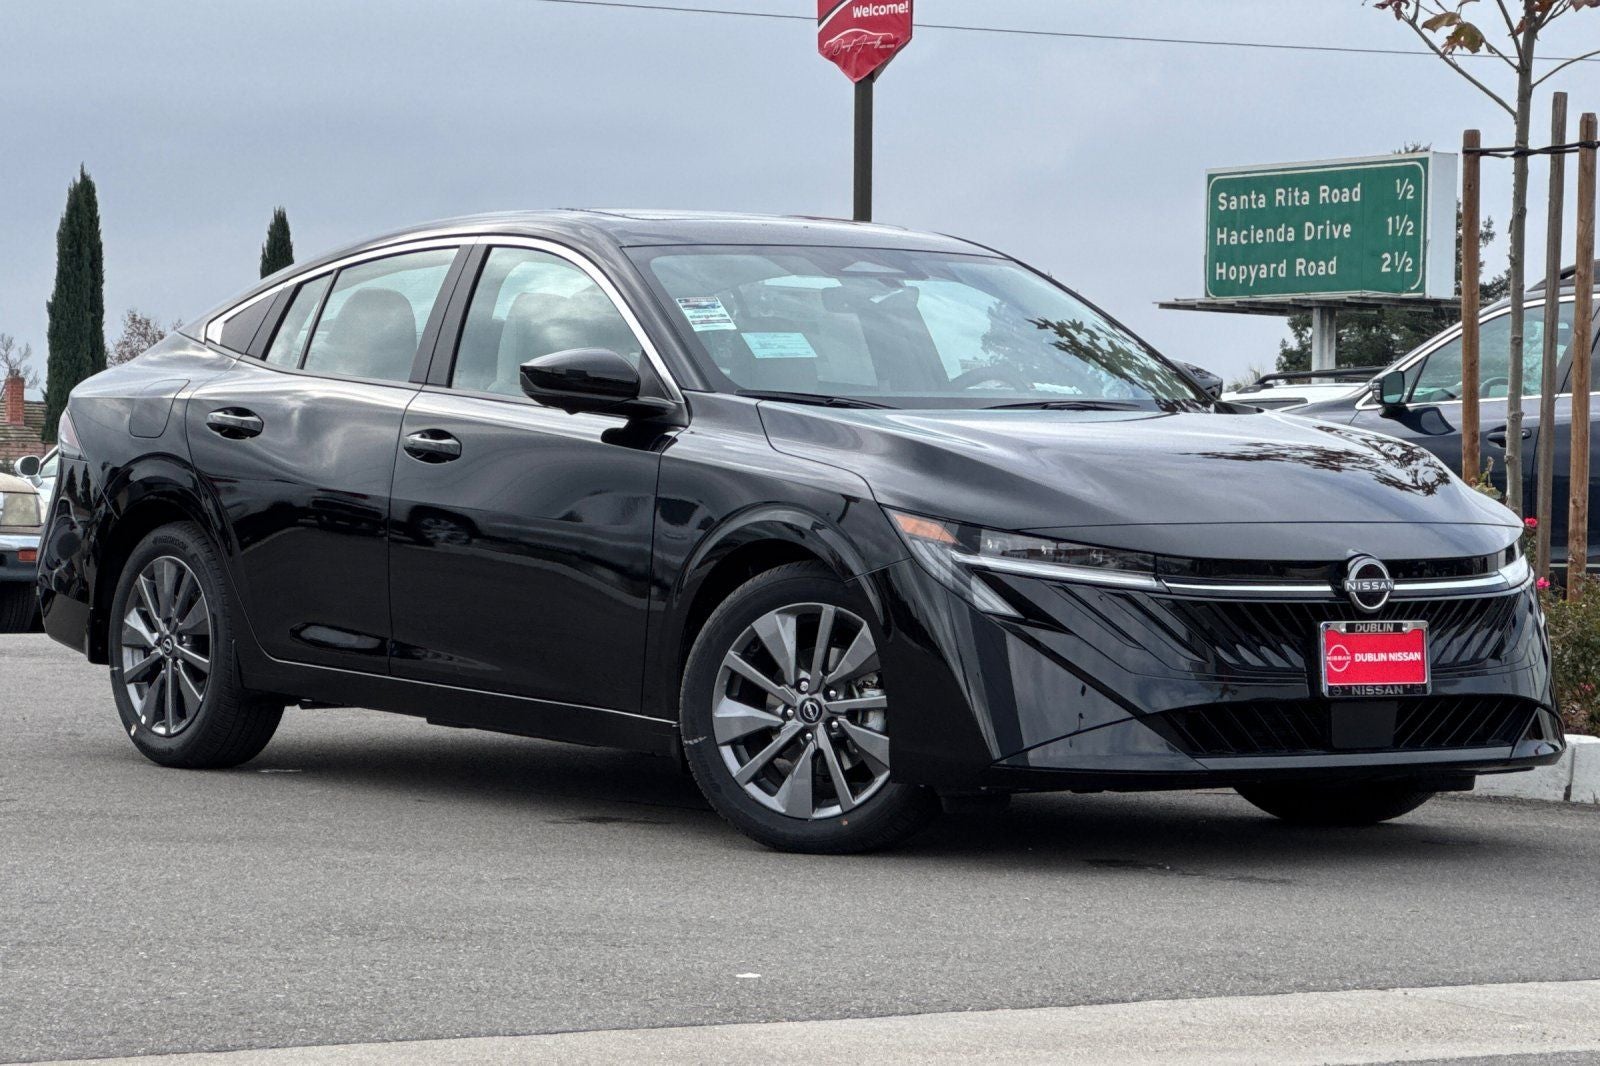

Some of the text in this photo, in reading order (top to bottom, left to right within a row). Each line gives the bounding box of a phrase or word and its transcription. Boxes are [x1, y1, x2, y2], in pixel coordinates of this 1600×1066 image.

[852, 1, 909, 18] Welcome!
[1218, 191, 1266, 211] Santa
[1275, 187, 1310, 207] Rita
[1319, 182, 1361, 204] Road
[1216, 223, 1295, 246] Hacienda
[1304, 220, 1351, 241] Drive
[1215, 259, 1287, 287] Hopyard
[1295, 256, 1337, 277] Road
[1346, 581, 1394, 591] NISSAN
[1355, 623, 1394, 633] DUBLIN
[1354, 652, 1421, 662] DUBLIN NISSAN
[1351, 685, 1403, 696] NISSAN
